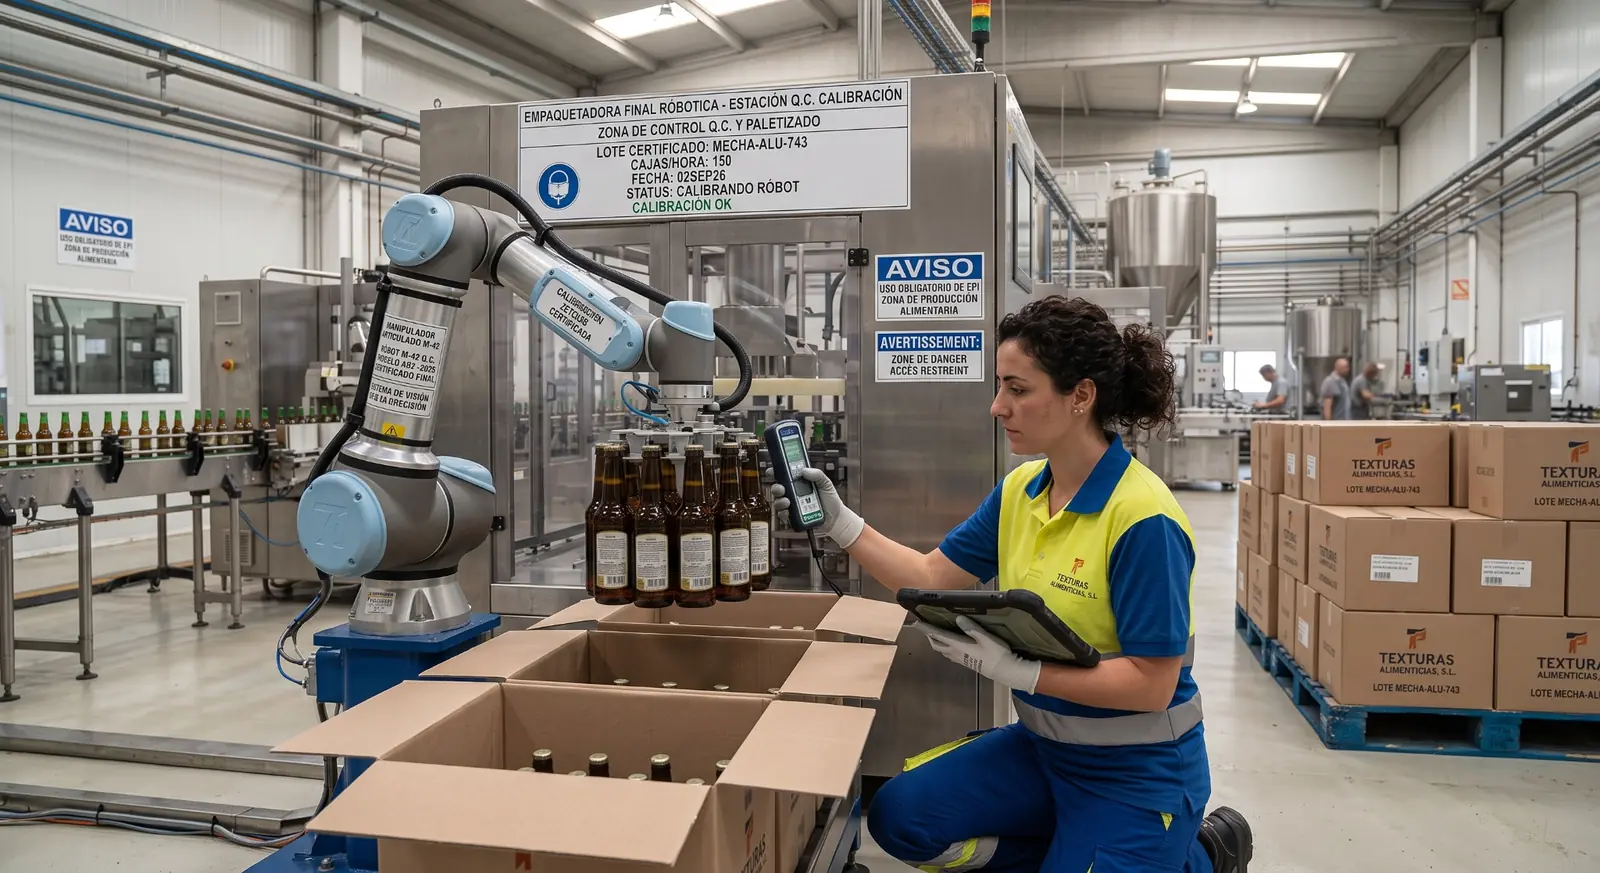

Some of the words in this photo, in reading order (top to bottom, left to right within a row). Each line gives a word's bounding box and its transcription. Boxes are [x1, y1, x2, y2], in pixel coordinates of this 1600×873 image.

[524, 105, 621, 123] EMPAQUETADORA
[625, 103, 656, 116] FINAL
[660, 99, 719, 114] RÓBOTICA
[730, 92, 787, 110] ESTACIÓN
[791, 94, 815, 106] Q.C.
[819, 86, 902, 105] CALIBRACIÓN
[598, 126, 628, 139] ZONA
[633, 125, 646, 136] DE
[650, 122, 705, 135] CONTROL
[709, 120, 731, 133] Q.C.
[736, 119, 743, 131] Y
[746, 115, 820, 130] PALETIZADO
[597, 146, 625, 158] LOTE
[629, 142, 709, 156] CERTIFICADO:
[713, 136, 807, 152] MECHA-ALU-743
[631, 157, 708, 170] CAJAS/HORA:
[713, 155, 731, 167] 150
[632, 173, 673, 185] FECHA:
[678, 170, 725, 183] 02SEP26
[627, 187, 673, 199] STATUS:
[677, 183, 753, 197] CALIBRANDO
[757, 179, 799, 194] RÓBOT
[633, 197, 711, 213] CALIBRACIÓN
[715, 199, 731, 210] OK
[65, 213, 128, 236] AVISO
[64, 244, 81, 252] ZONA
[77, 255, 116, 265] ALIMENTARIA
[886, 258, 973, 278] AVISO
[880, 285, 895, 293] USO
[899, 283, 951, 292] OBLIGATORIO
[954, 283, 964, 291] DE
[967, 283, 979, 291] EPI
[882, 296, 904, 304] ZONA
[907, 295, 918, 303] DE
[921, 292, 978, 303] PRODUCCIÓN
[900, 306, 958, 315] ALIMENTARIA
[386, 322, 435, 339] MANIPULADOR
[382, 330, 421, 346] ARTICULADO
[423, 340, 440, 350] M-42
[880, 336, 979, 349] AVERTISSEMENT:
[401, 351, 420, 360] M-42
[892, 355, 914, 364] ZONE
[917, 355, 928, 363] DE
[931, 355, 967, 363] DANGER
[890, 364, 918, 375] ACCÈS
[921, 366, 968, 375] RESTREINT
[416, 374, 435, 383] FINAL
[380, 395, 387, 403] LA
[394, 389, 403, 397] DE
[406, 391, 429, 402] VISIÓN
[1352, 459, 1415, 469] TEXTURAS
[1541, 466, 1600, 478] TEXTUR
[1057, 573, 1088, 589] TEXTURAS
[1379, 652, 1454, 665] TEXTURAS
[1380, 666, 1439, 676] ALIMENTICIAS,
[1373, 684, 1393, 692] LOTE
[1396, 684, 1460, 694] MECHA-ALU-743
[1531, 689, 1552, 697] LOTE
[1554, 690, 1600, 699] MECHA-AL
